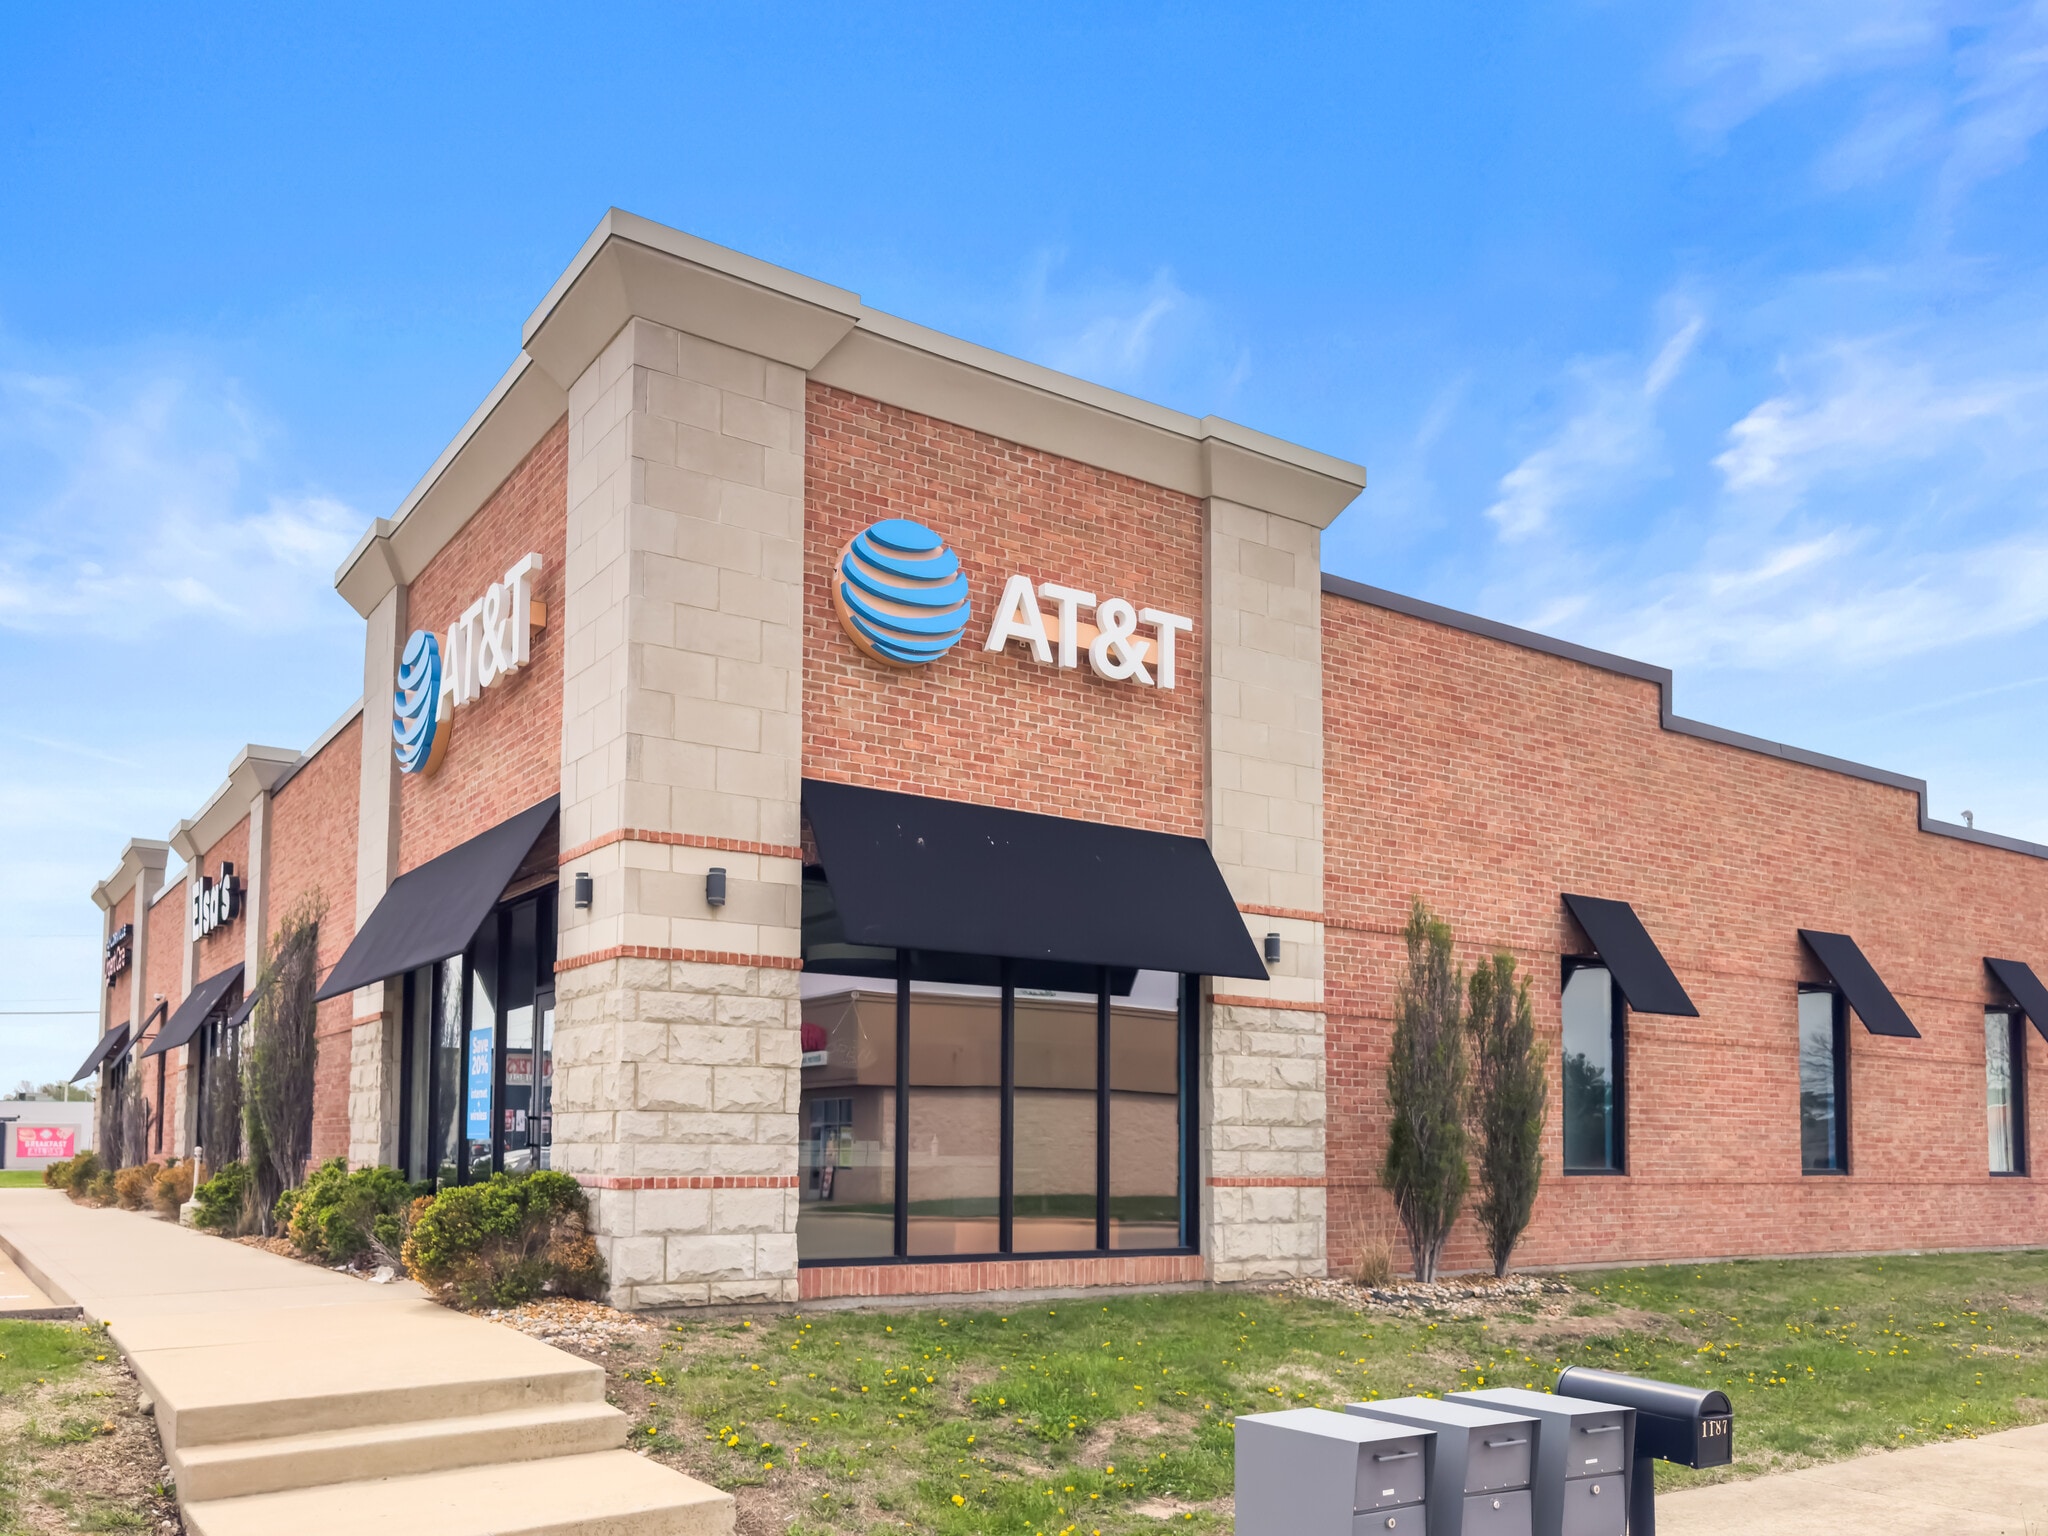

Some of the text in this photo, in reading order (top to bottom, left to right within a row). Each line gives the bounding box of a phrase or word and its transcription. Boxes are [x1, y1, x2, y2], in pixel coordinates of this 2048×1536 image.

[435, 552, 538, 722] AT&T
[984, 575, 1192, 690] AT&T
[192, 861, 231, 942] Elsa's
[472, 1036, 488, 1054] Save
[471, 1054, 489, 1075] 20%
[470, 1088, 488, 1099] internet
[470, 1109, 487, 1121] wireless
[25, 1140, 67, 1148] BREAKFAST
[1702, 1420, 1727, 1438] 1187
